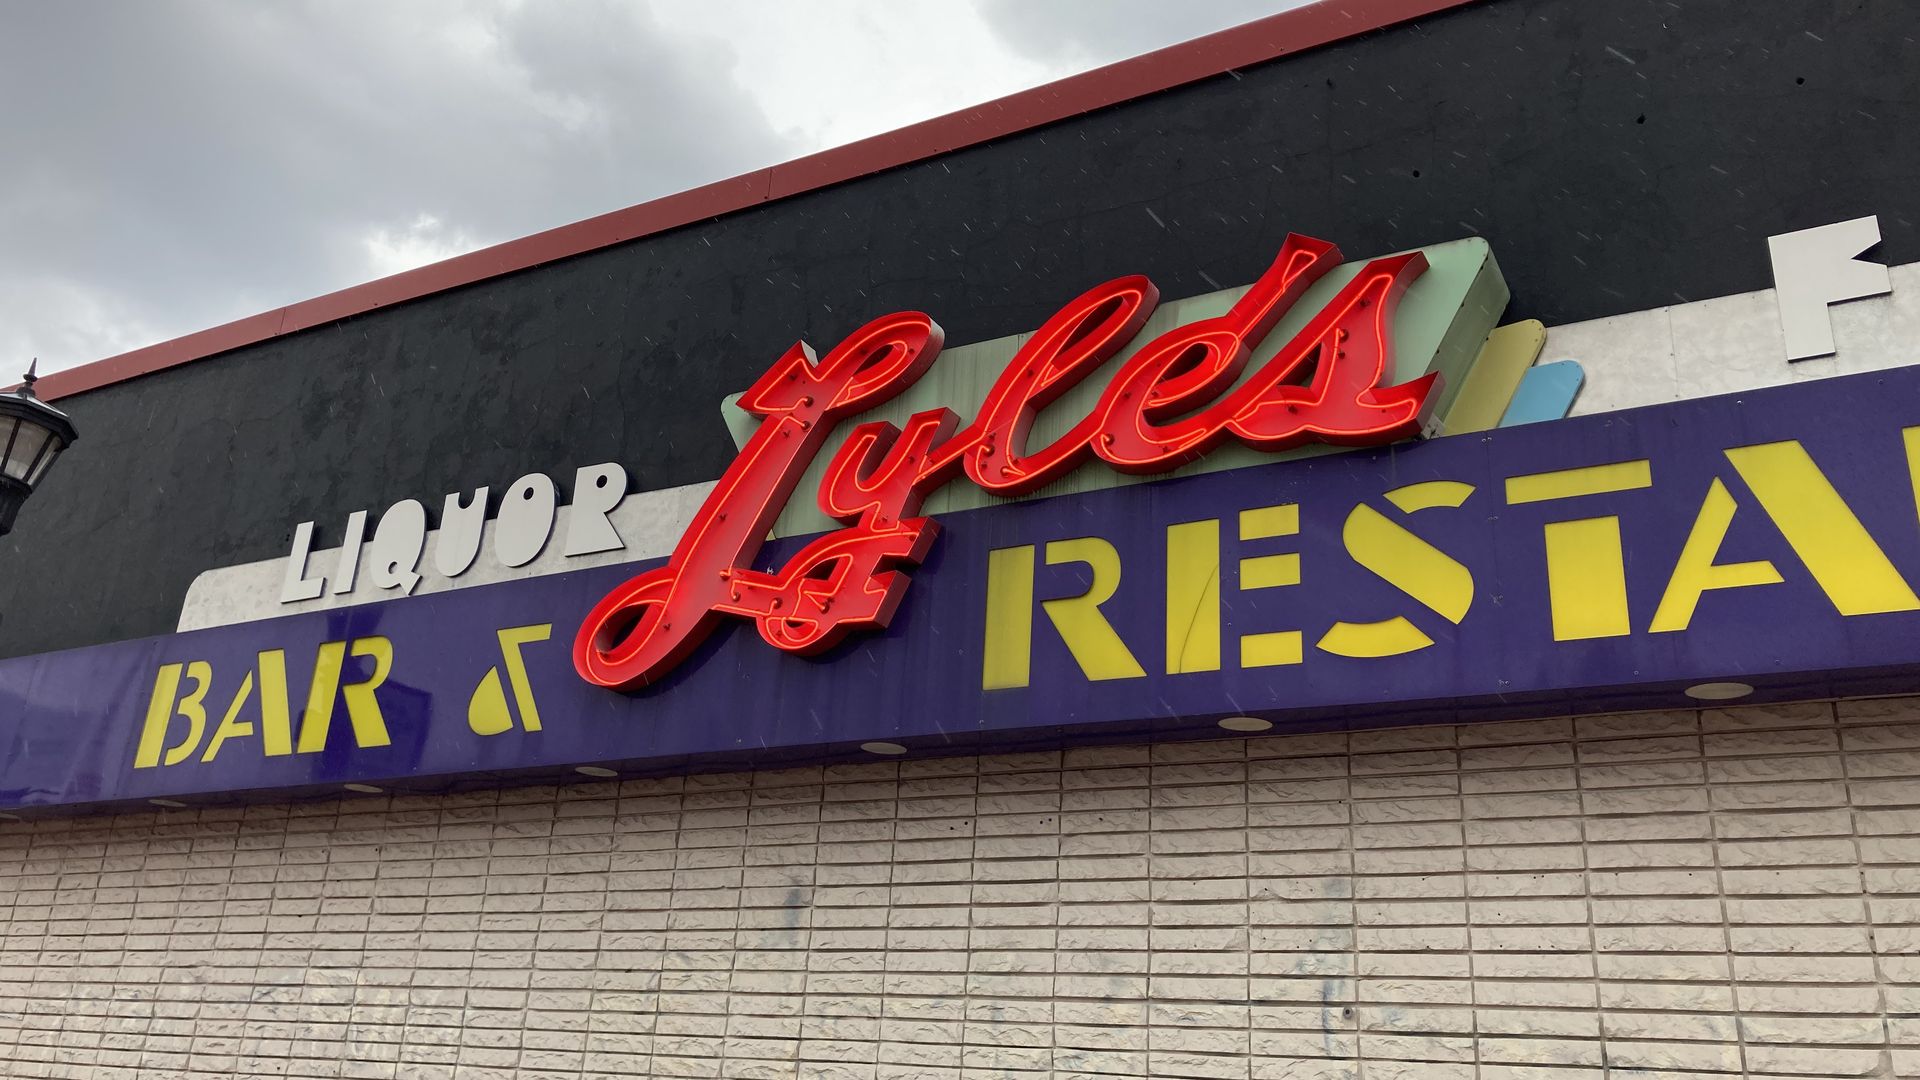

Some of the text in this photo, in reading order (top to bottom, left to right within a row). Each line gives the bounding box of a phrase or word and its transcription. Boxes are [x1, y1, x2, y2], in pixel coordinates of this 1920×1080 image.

[134, 635, 393, 770] BAR
[981, 425, 1920, 690] RESTA
[281, 461, 628, 605] LIQUOR
